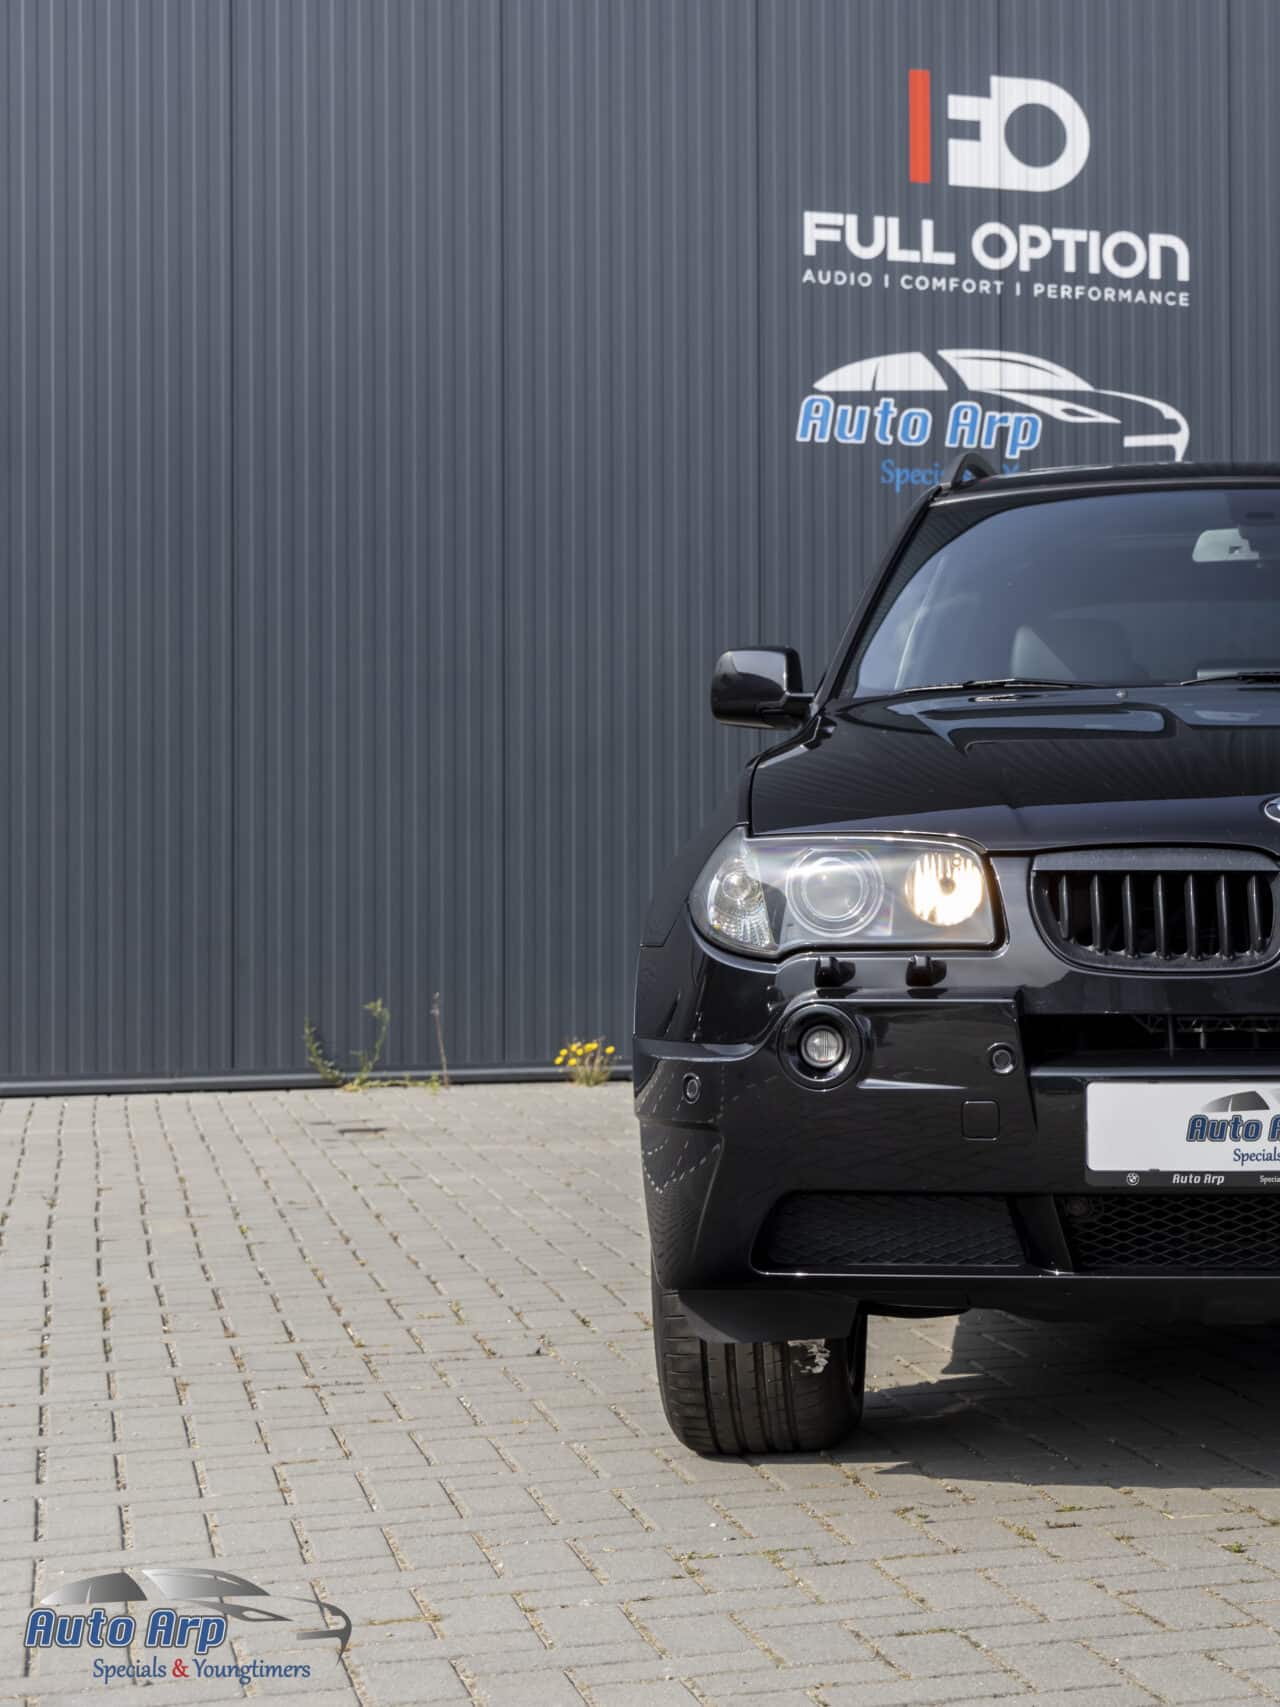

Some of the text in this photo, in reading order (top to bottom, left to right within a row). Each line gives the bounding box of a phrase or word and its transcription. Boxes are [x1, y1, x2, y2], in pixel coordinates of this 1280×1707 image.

[803, 211, 1190, 281] FULL OPTION
[802, 269, 873, 287] AUDIO
[900, 274, 1004, 296] COMFORT
[1033, 283, 1190, 307] PERFORMANCE
[796, 394, 1042, 459] Auto Arp
[879, 458, 976, 494] Speci
[1186, 1114, 1263, 1142] Auto
[1172, 1174, 1201, 1184] Auto
[1203, 1174, 1225, 1186] Arp
